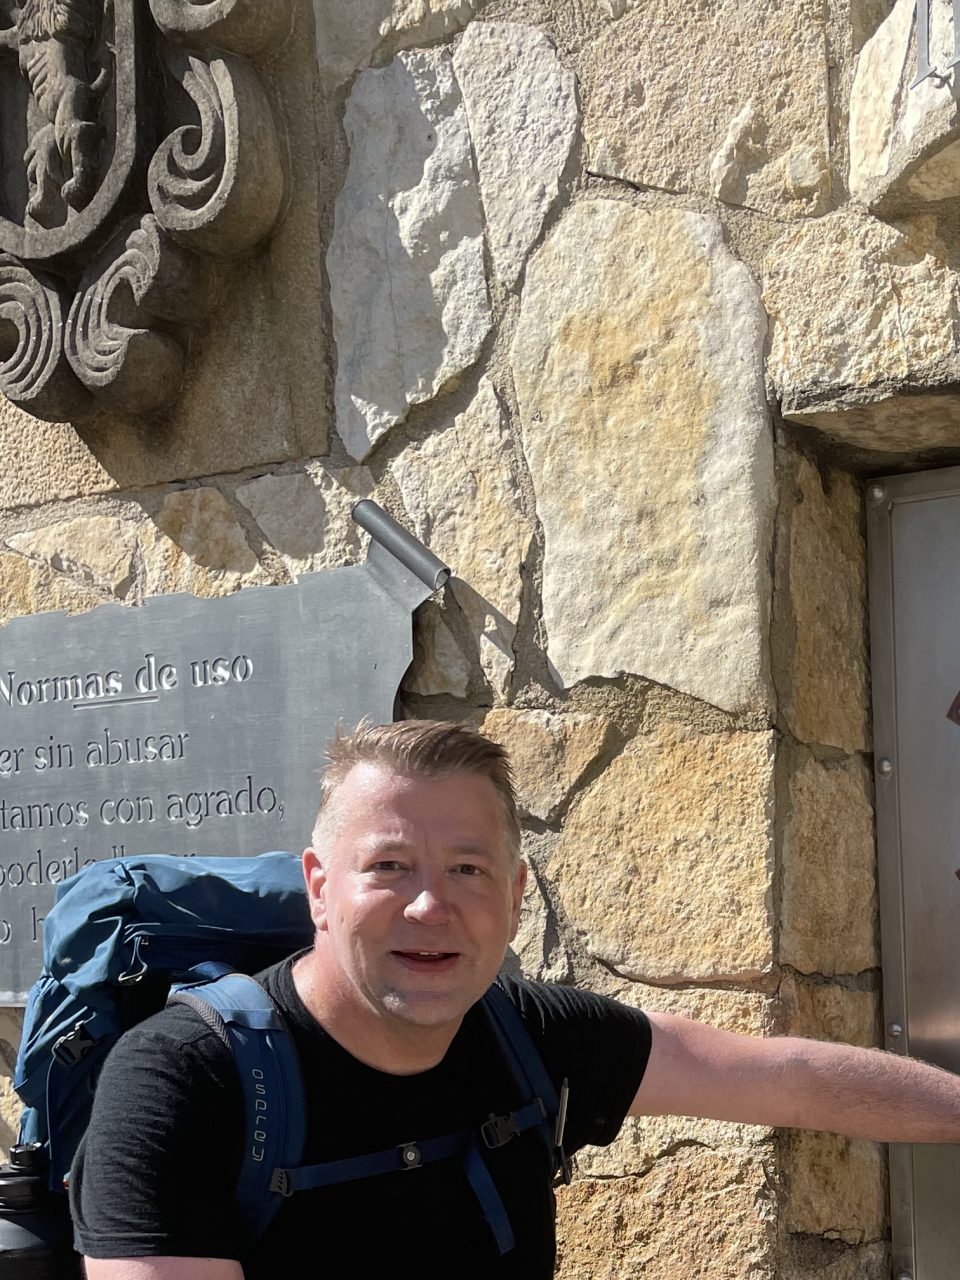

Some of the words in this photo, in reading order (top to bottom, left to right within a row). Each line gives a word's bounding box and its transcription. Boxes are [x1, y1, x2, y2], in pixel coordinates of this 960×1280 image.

[0, 669, 123, 706] Normas
[134, 654, 178, 694] de
[190, 653, 255, 686] uso
[34, 735, 74, 769] sin
[86, 728, 189, 767] abusar
[99, 794, 155, 825] con
[166, 775, 285, 829] agrado,
[251, 1068, 267, 1162] osprey
